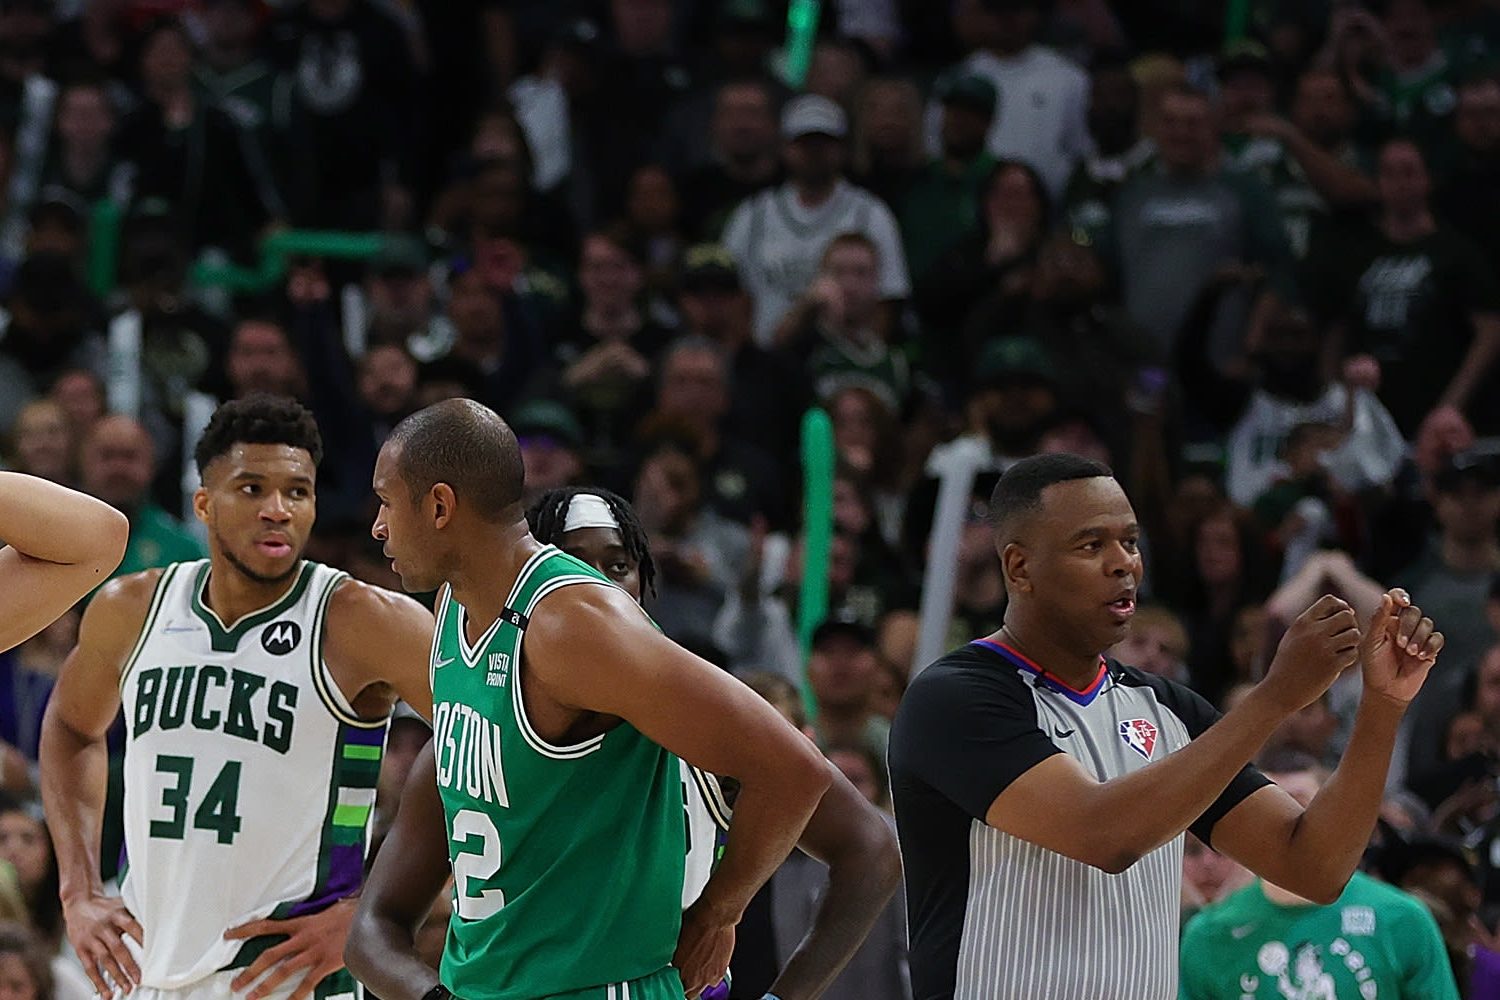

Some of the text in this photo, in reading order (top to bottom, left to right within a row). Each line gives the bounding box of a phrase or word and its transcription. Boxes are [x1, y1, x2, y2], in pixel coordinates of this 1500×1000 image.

[485, 672, 507, 687] PRINT
[488, 652, 510, 673] VISTA
[133, 665, 299, 755] BUCKS
[432, 701, 510, 809] OSTON
[149, 754, 242, 845] 34
